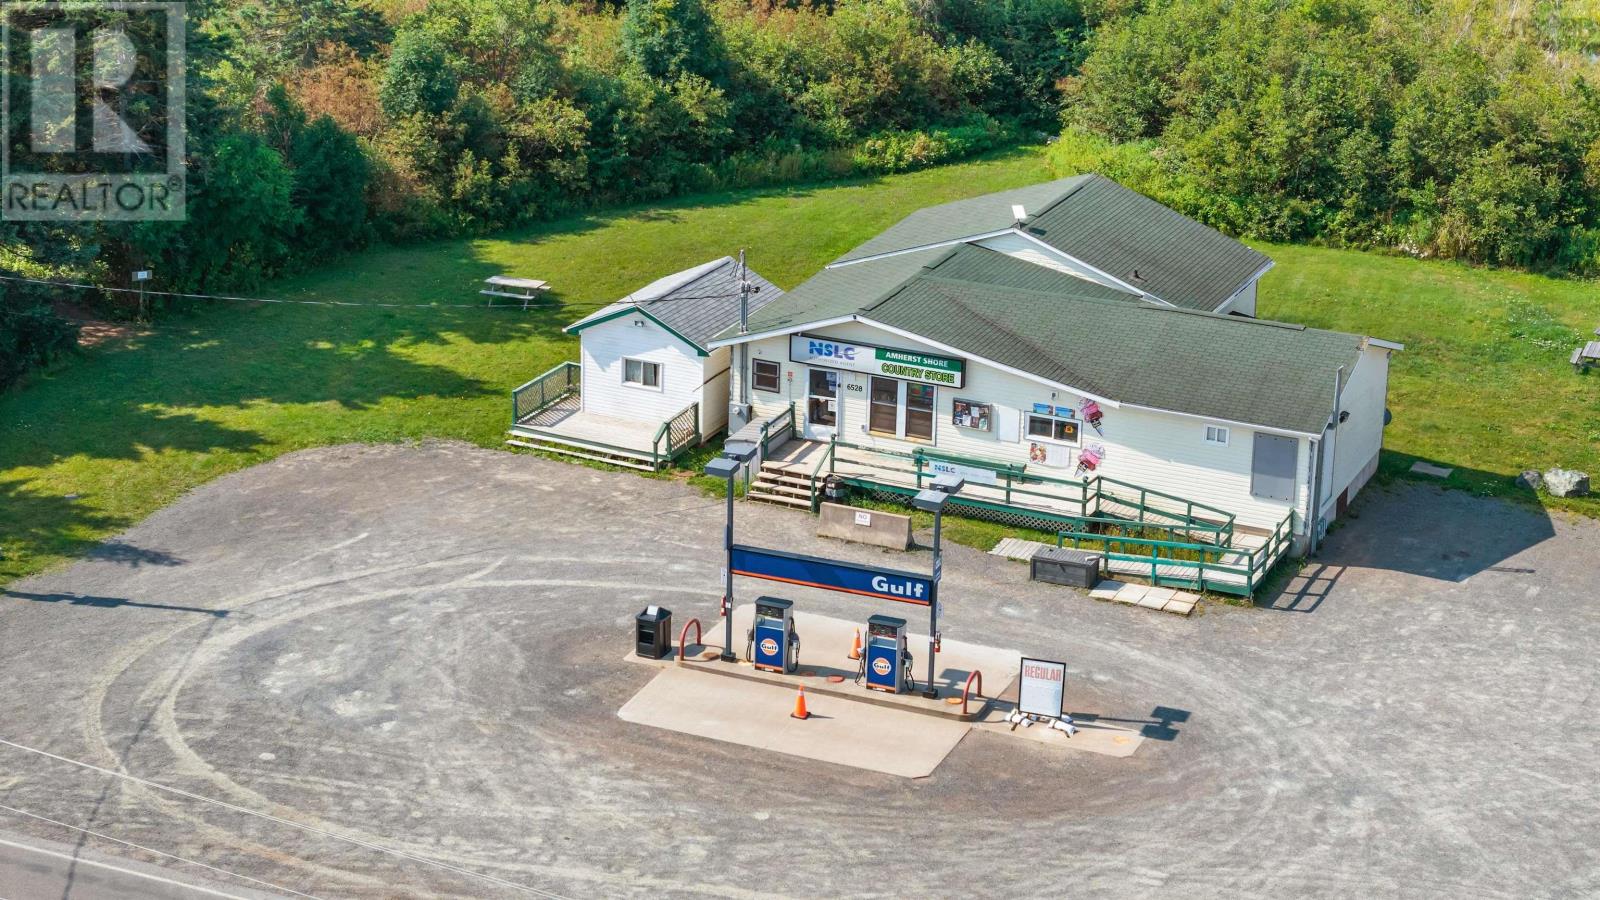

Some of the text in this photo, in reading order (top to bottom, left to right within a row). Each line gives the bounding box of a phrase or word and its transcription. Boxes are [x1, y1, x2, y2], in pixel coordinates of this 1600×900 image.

[809, 341, 855, 361] NSLC
[885, 351, 949, 368] AMHERST SHORE
[881, 362, 955, 384] COUNTRY STORE
[846, 383, 863, 393] 6528
[934, 464, 956, 474] NSLC
[871, 576, 924, 598] Gulf
[760, 642, 779, 652] Gulf
[873, 661, 891, 671] Gulf
[1024, 665, 1062, 682] REGULAR
